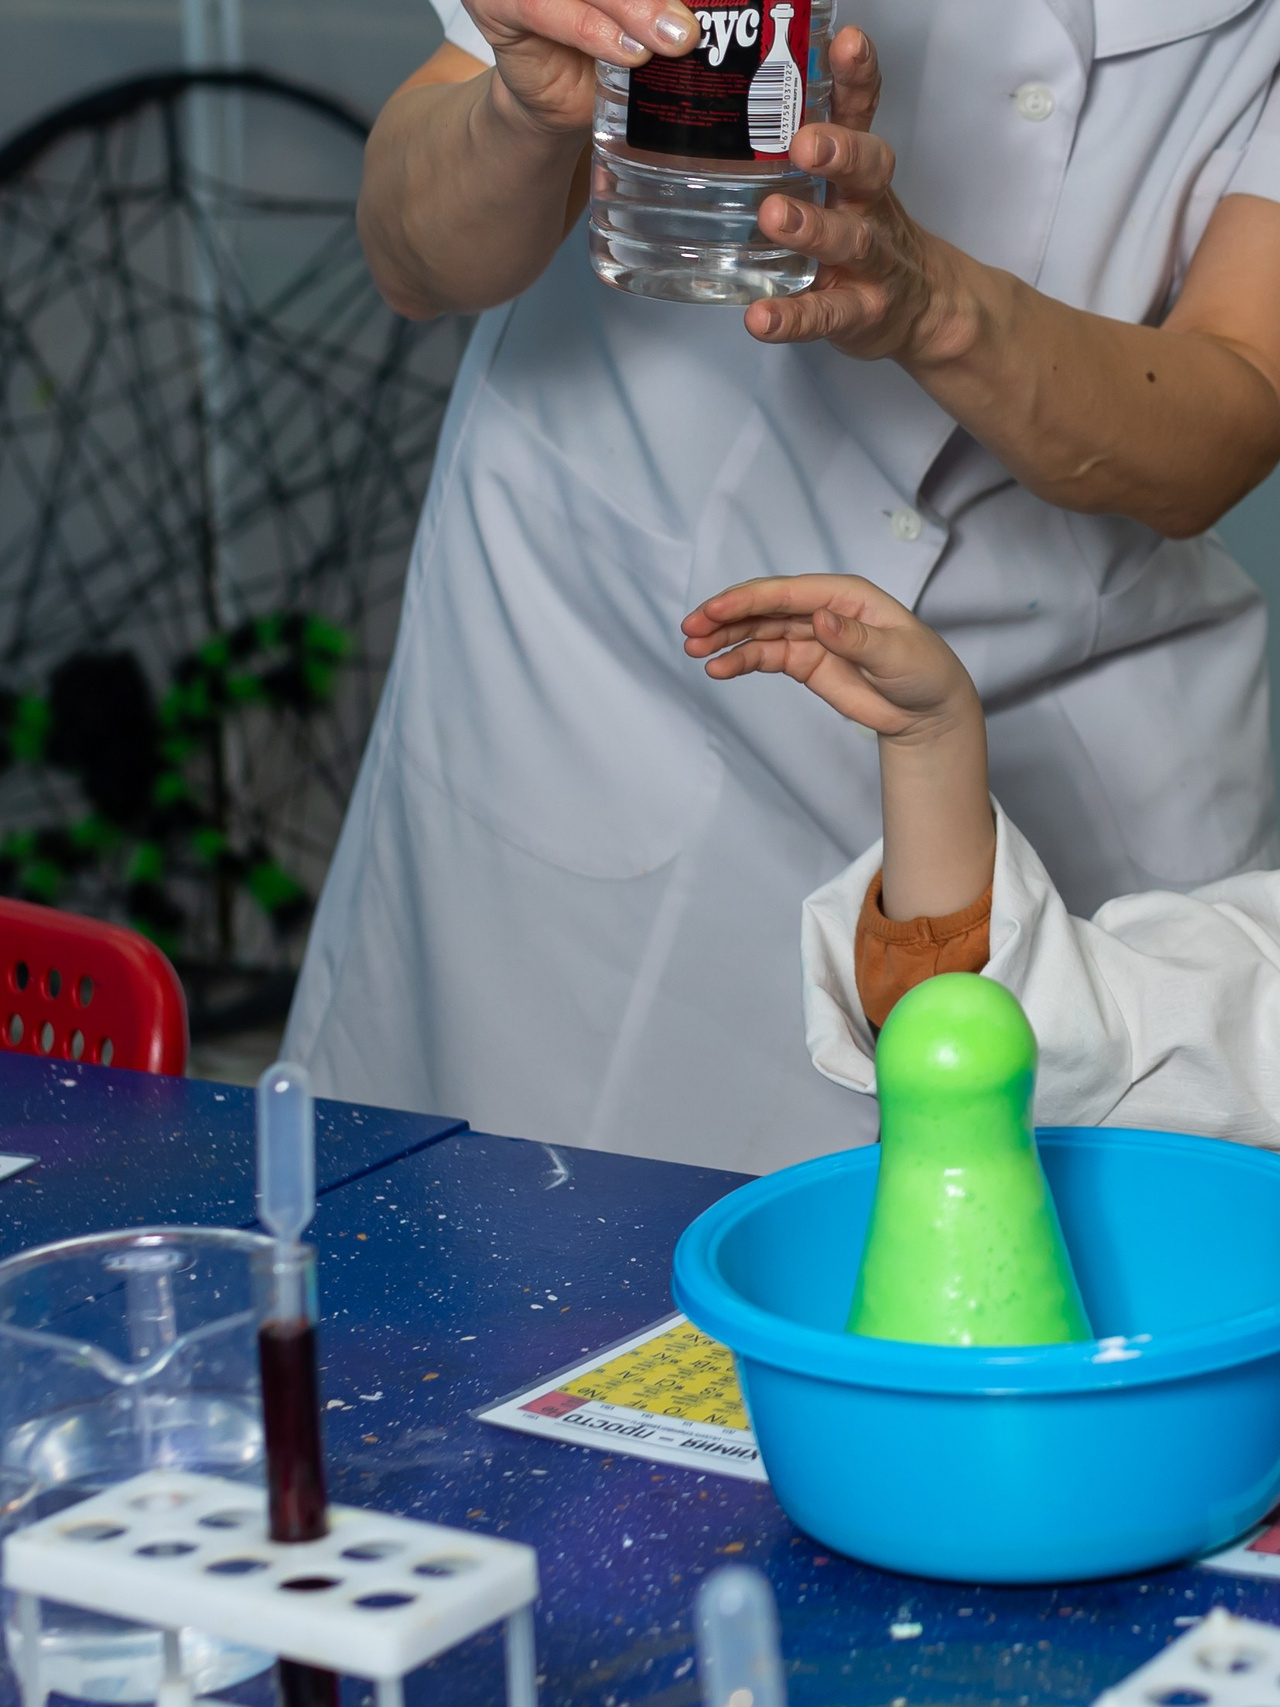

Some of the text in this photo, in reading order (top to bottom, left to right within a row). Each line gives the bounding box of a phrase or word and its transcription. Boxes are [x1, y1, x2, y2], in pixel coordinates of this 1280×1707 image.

[695, 8, 760, 67] сус
[783, 63, 793, 100] 037022
[781, 104, 790, 141] 673758
[654, 1378, 676, 1387] Cl
[577, 1387, 603, 1399] Ne
[663, 1406, 682, 1415] O
[703, 1413, 723, 1423] N
